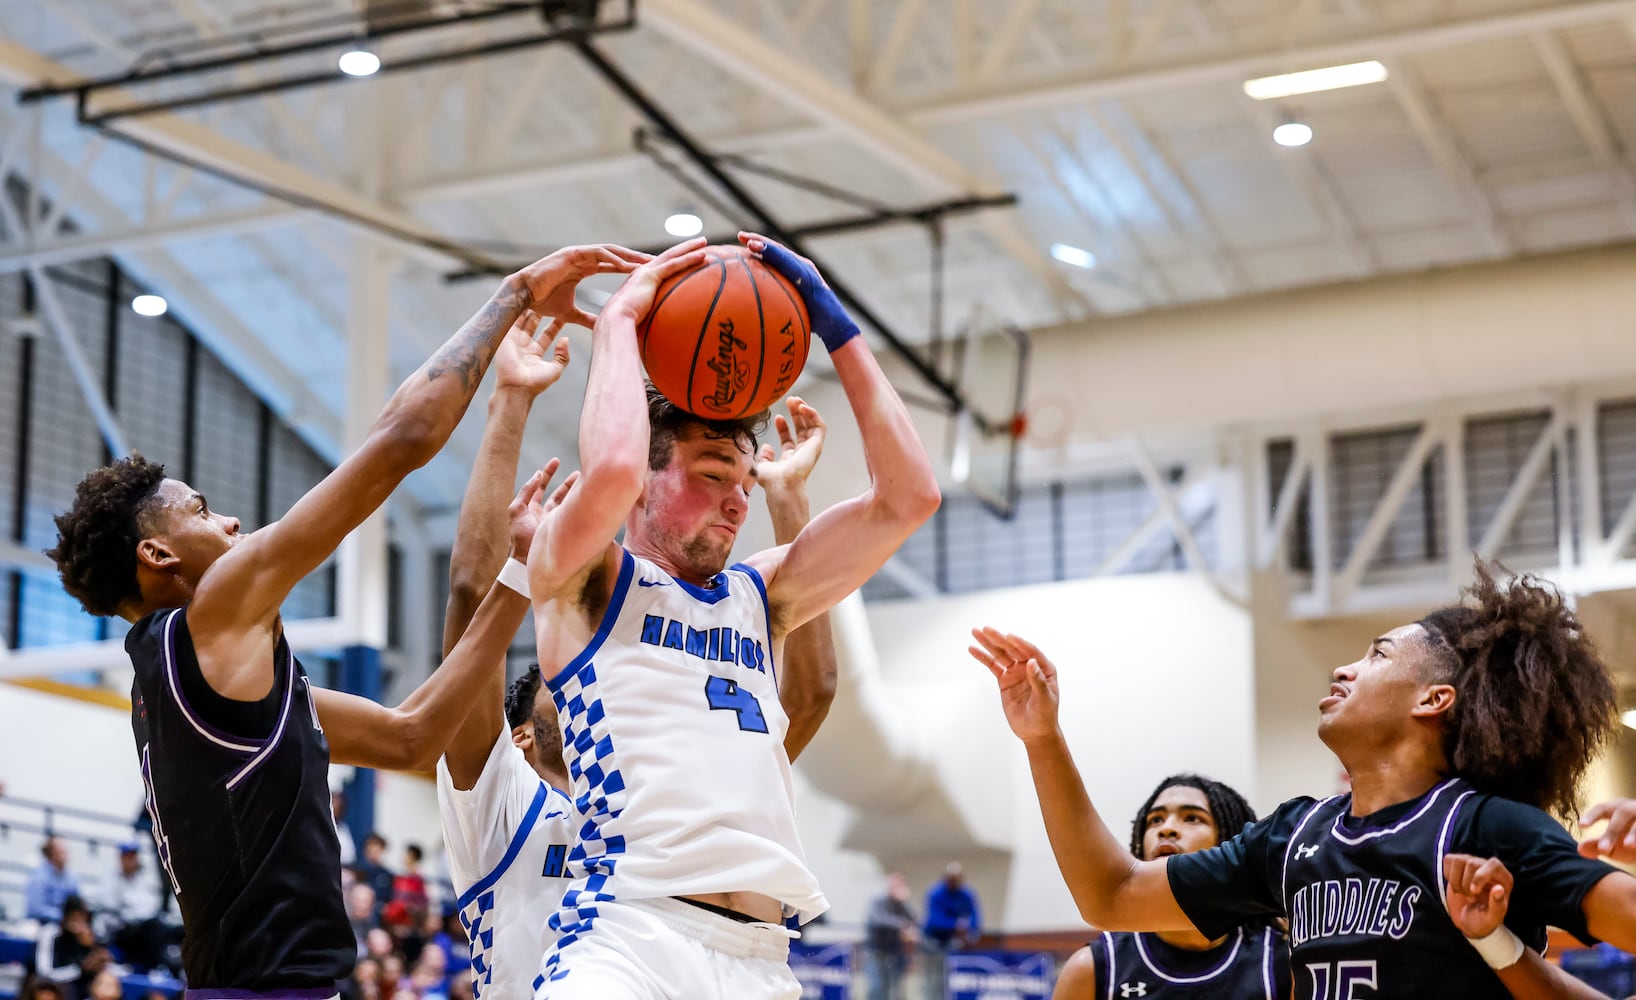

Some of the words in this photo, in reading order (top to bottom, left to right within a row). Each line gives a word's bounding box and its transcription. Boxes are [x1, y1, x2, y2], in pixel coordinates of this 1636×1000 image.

[702, 318, 747, 414] Rawlings
[704, 674, 769, 734] 4
[1292, 877, 1422, 948] MIDDIES
